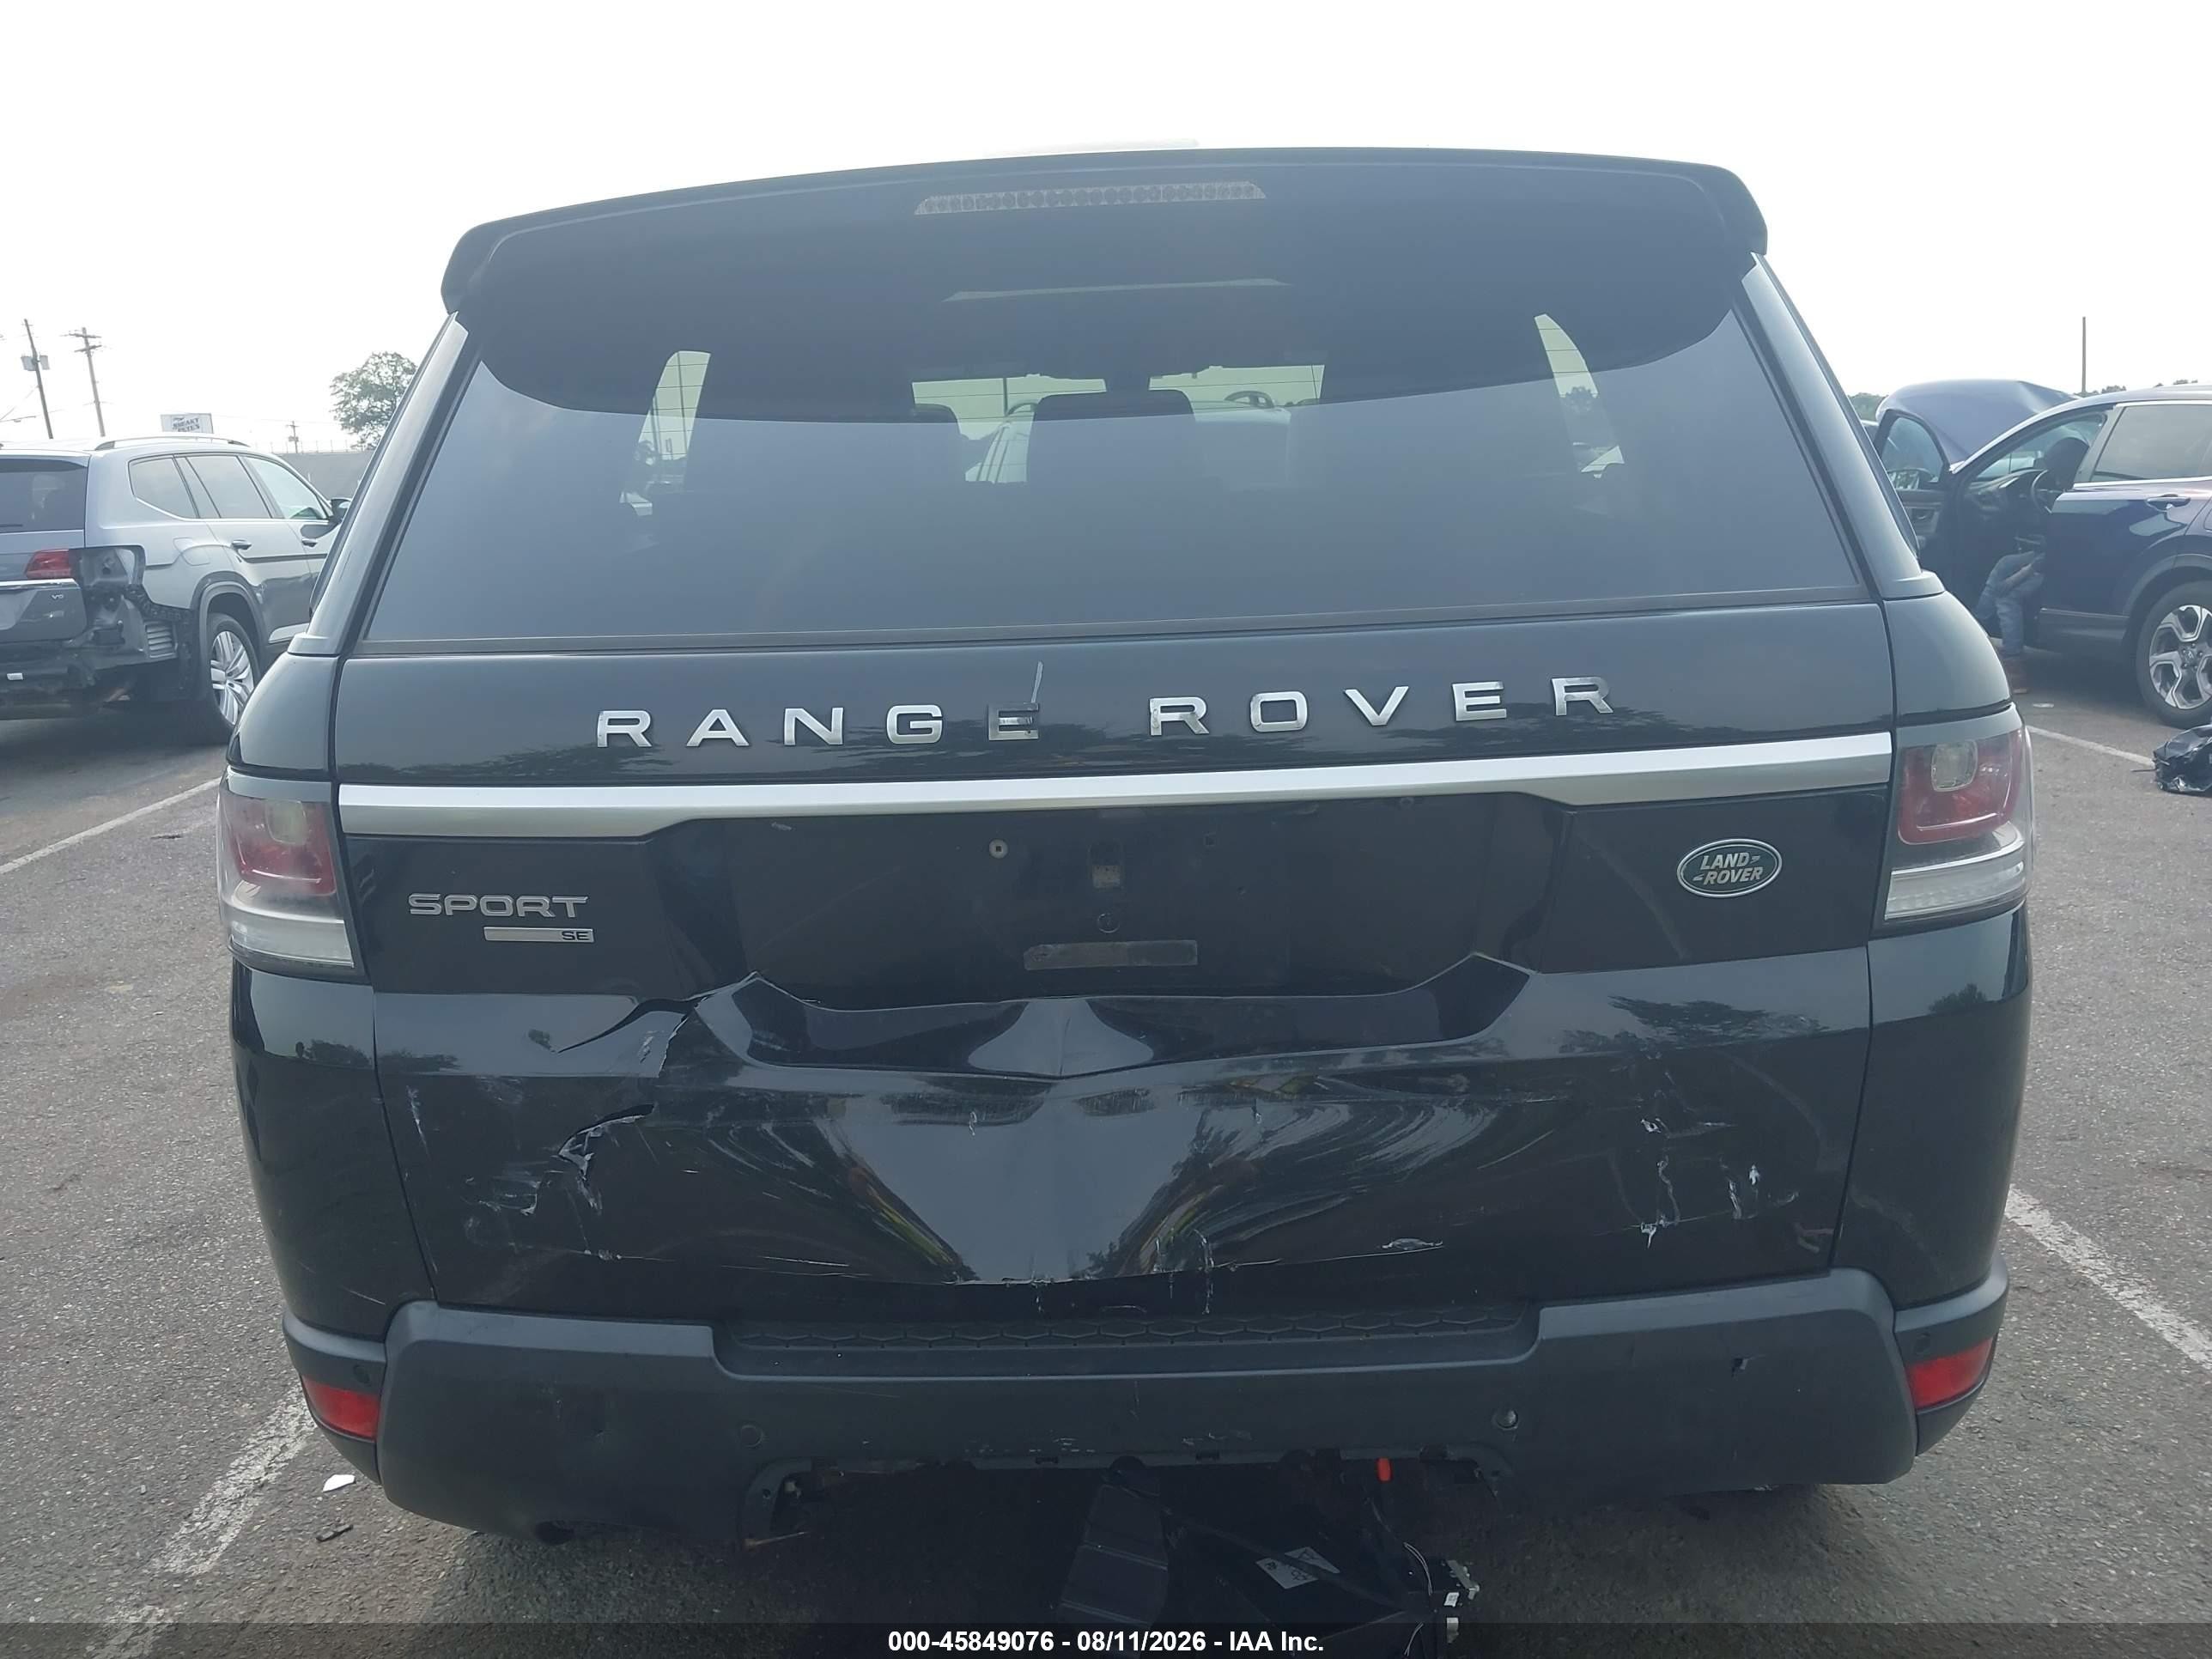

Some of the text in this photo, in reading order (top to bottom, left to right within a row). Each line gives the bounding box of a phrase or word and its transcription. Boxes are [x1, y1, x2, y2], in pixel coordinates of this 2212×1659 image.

[596, 676, 1614, 748] RANGE ROVER
[408, 892, 588, 918] SPORT
[561, 931, 590, 941] SE
